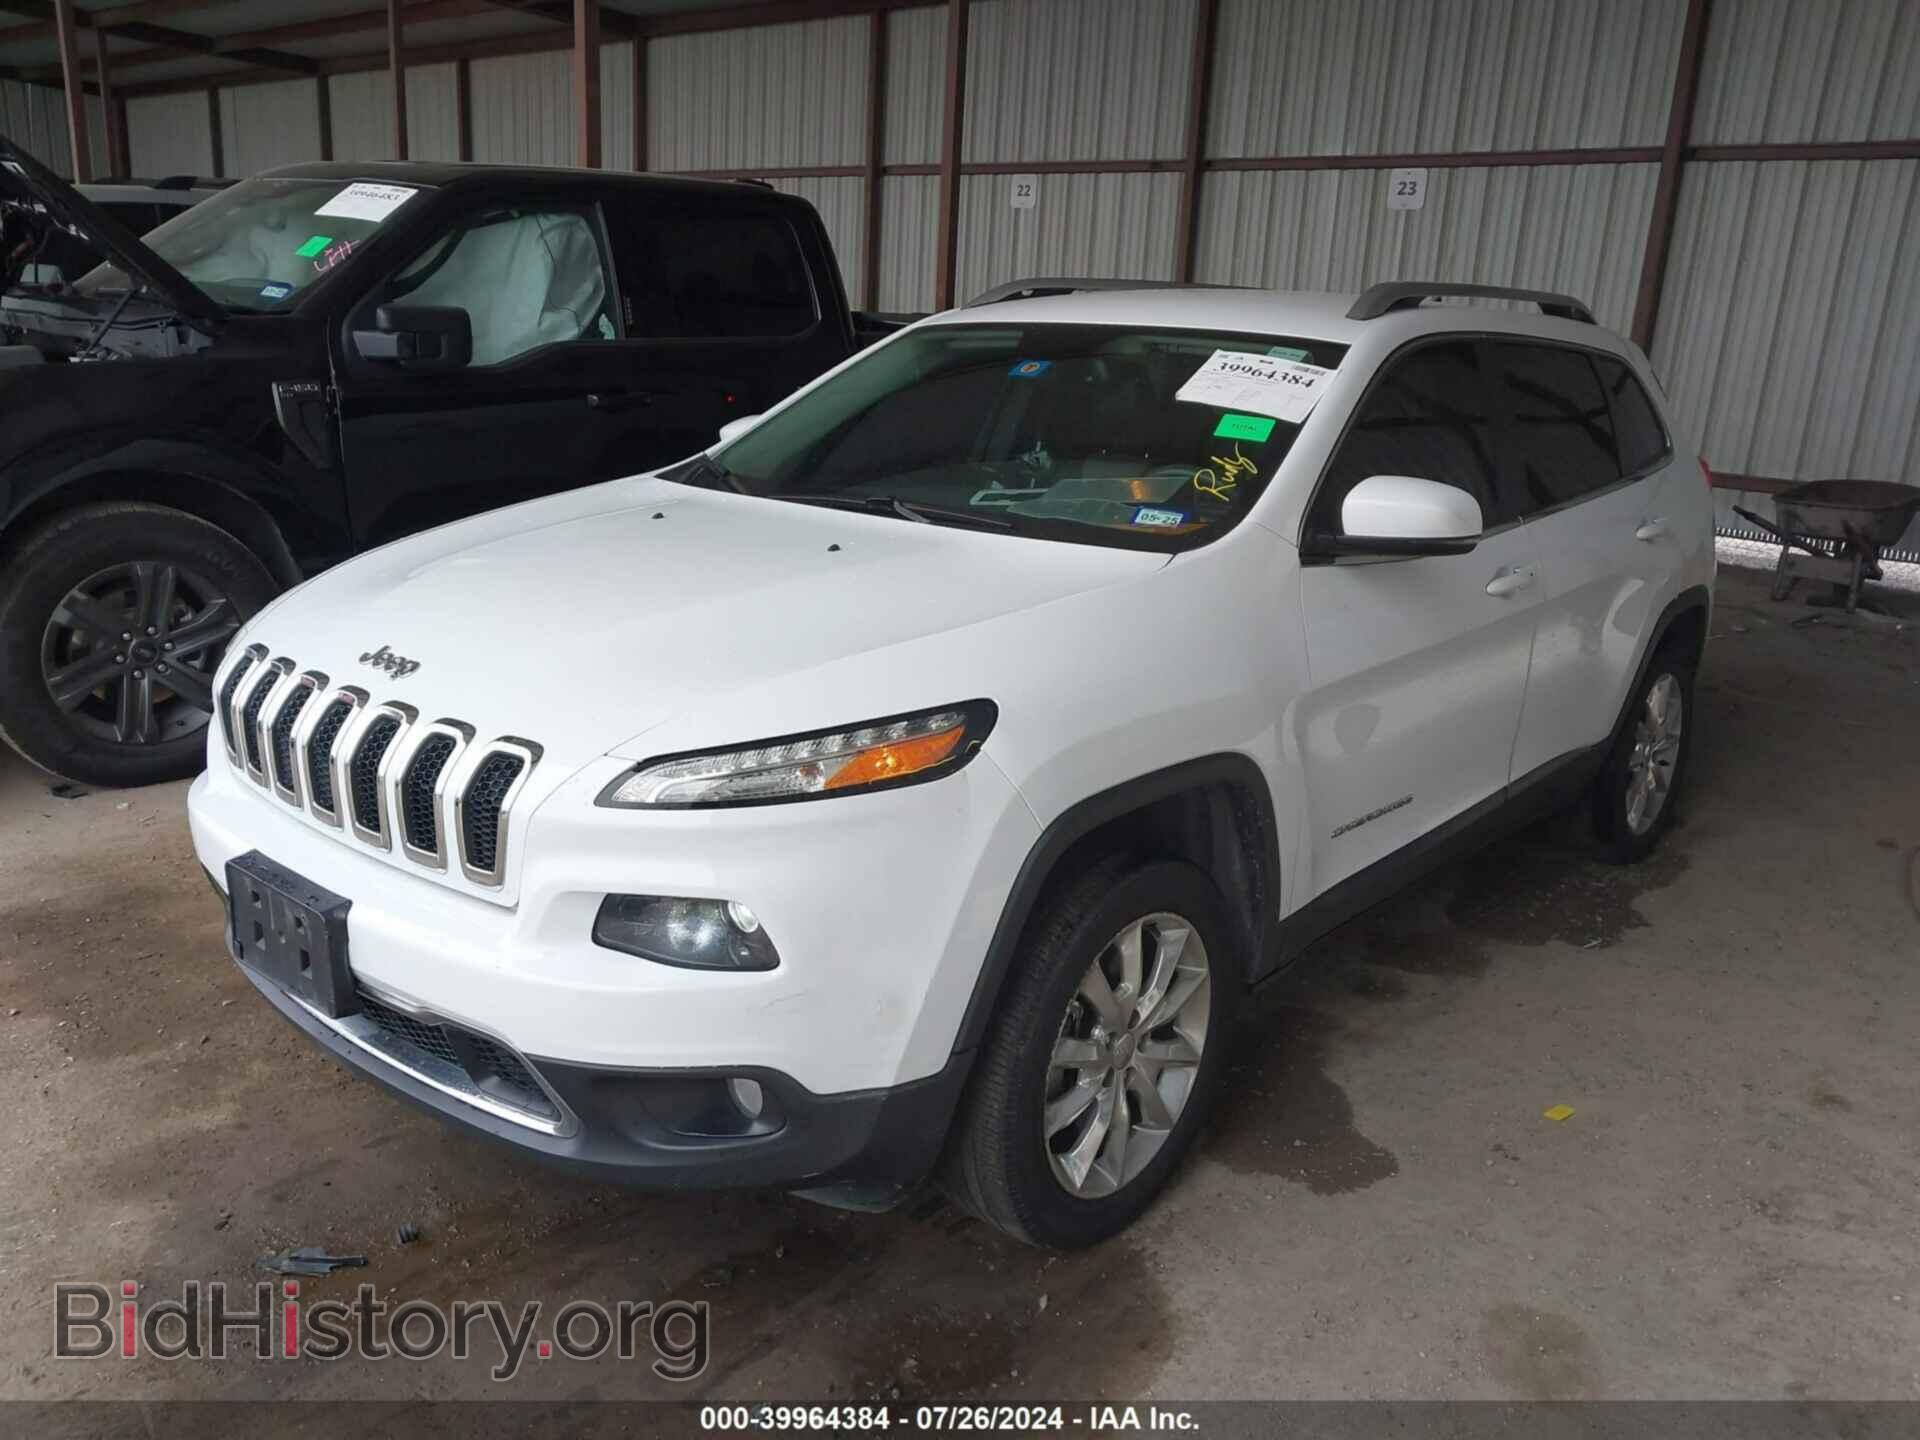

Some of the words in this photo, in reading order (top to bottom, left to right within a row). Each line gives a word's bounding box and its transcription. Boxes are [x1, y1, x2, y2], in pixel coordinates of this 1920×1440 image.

[1016, 184, 1032, 197] 22
[1397, 181, 1417, 196] 23
[1213, 361, 1315, 388] 39964384
[358, 645, 421, 680] Jeep
